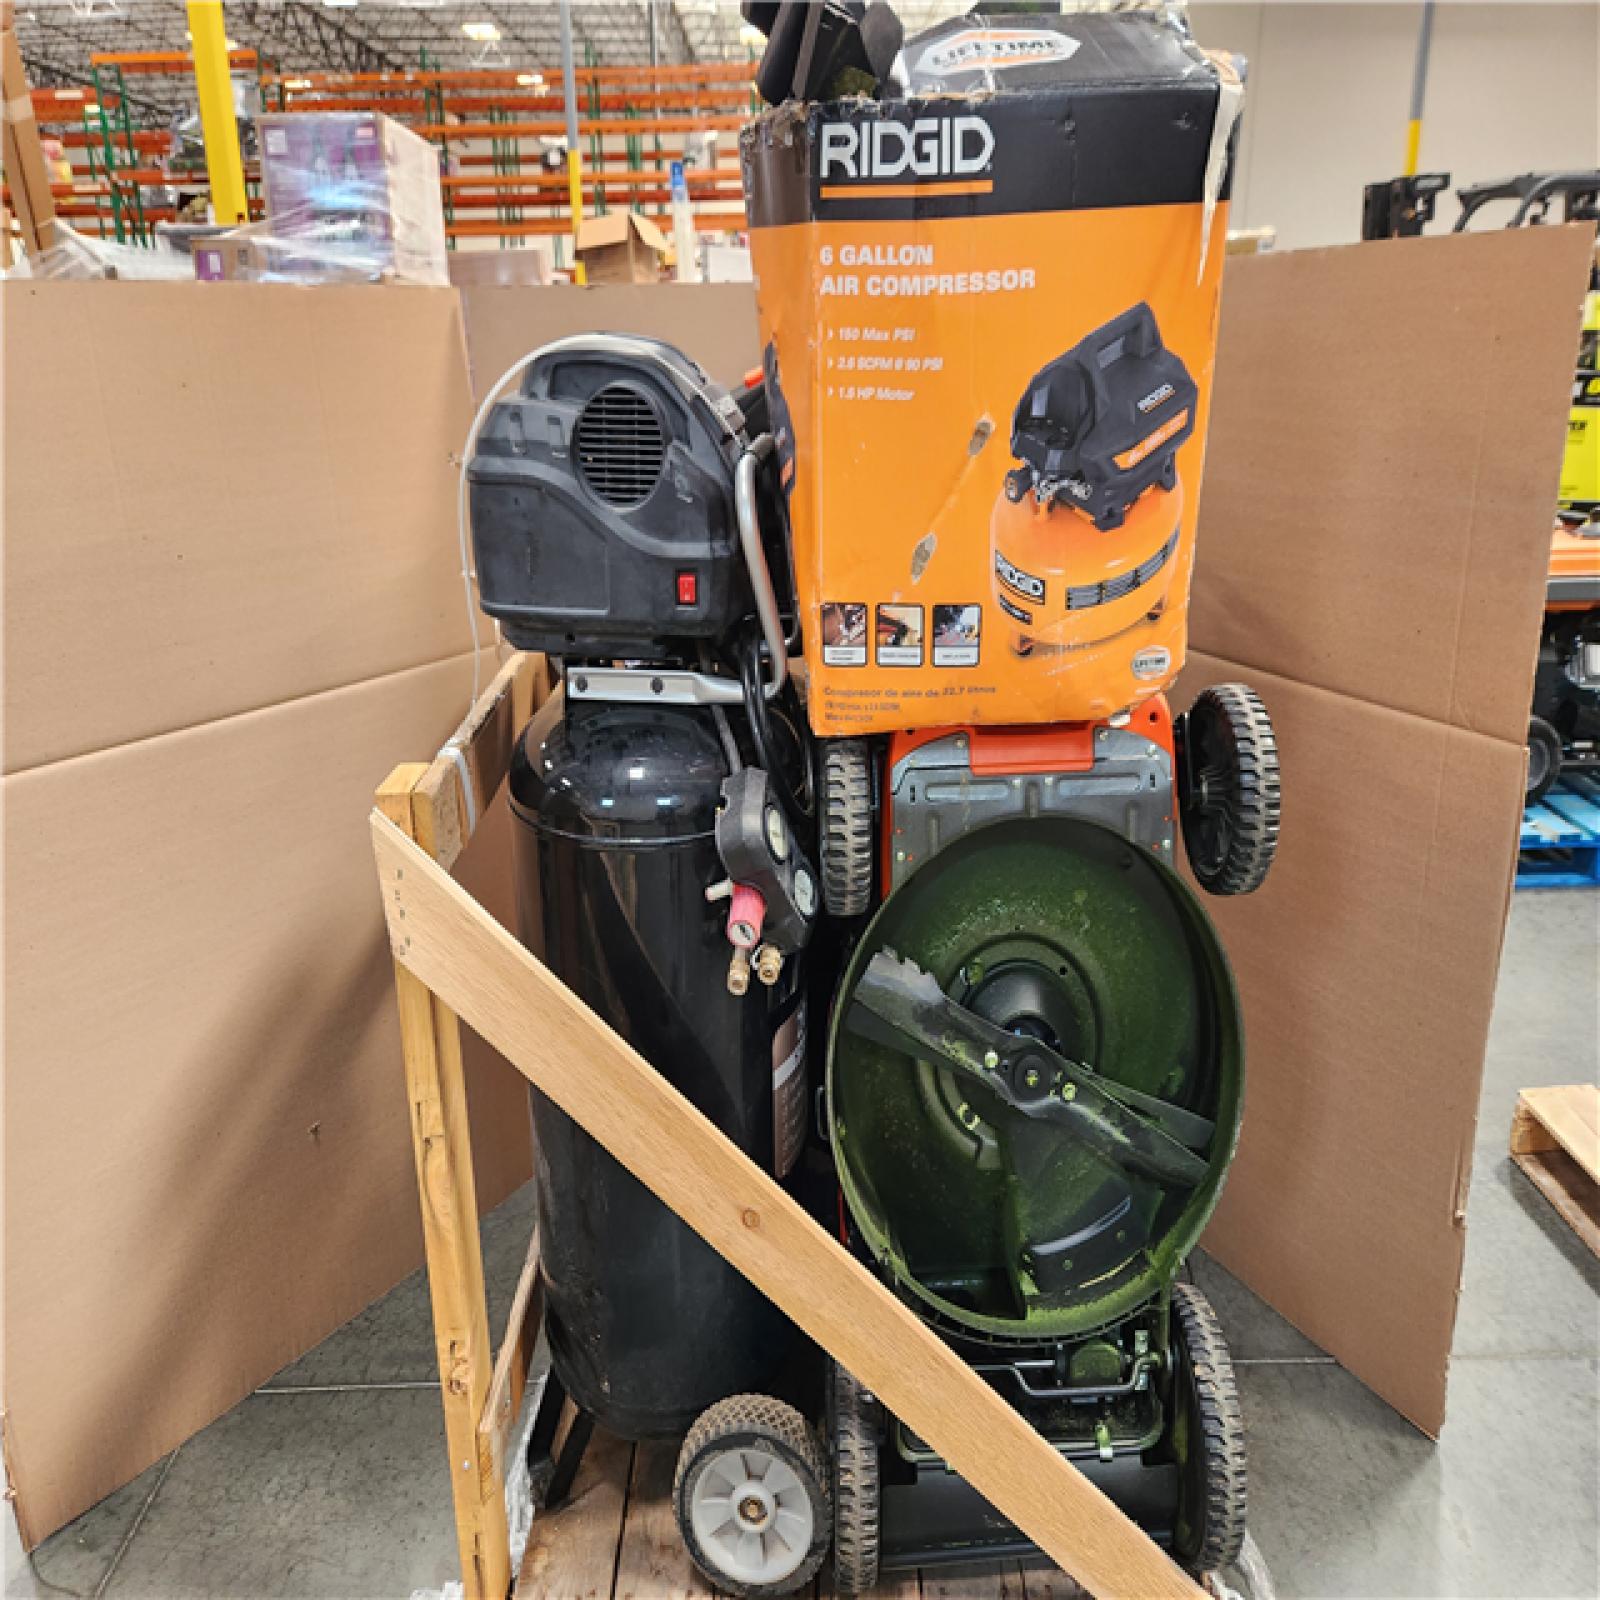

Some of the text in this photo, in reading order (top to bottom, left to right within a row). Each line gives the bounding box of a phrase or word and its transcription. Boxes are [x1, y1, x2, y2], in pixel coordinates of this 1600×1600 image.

[820, 117, 995, 178] RIDGID
[820, 245, 934, 266] 6 GALLON
[820, 267, 1036, 296] AIR COMPRESSOR
